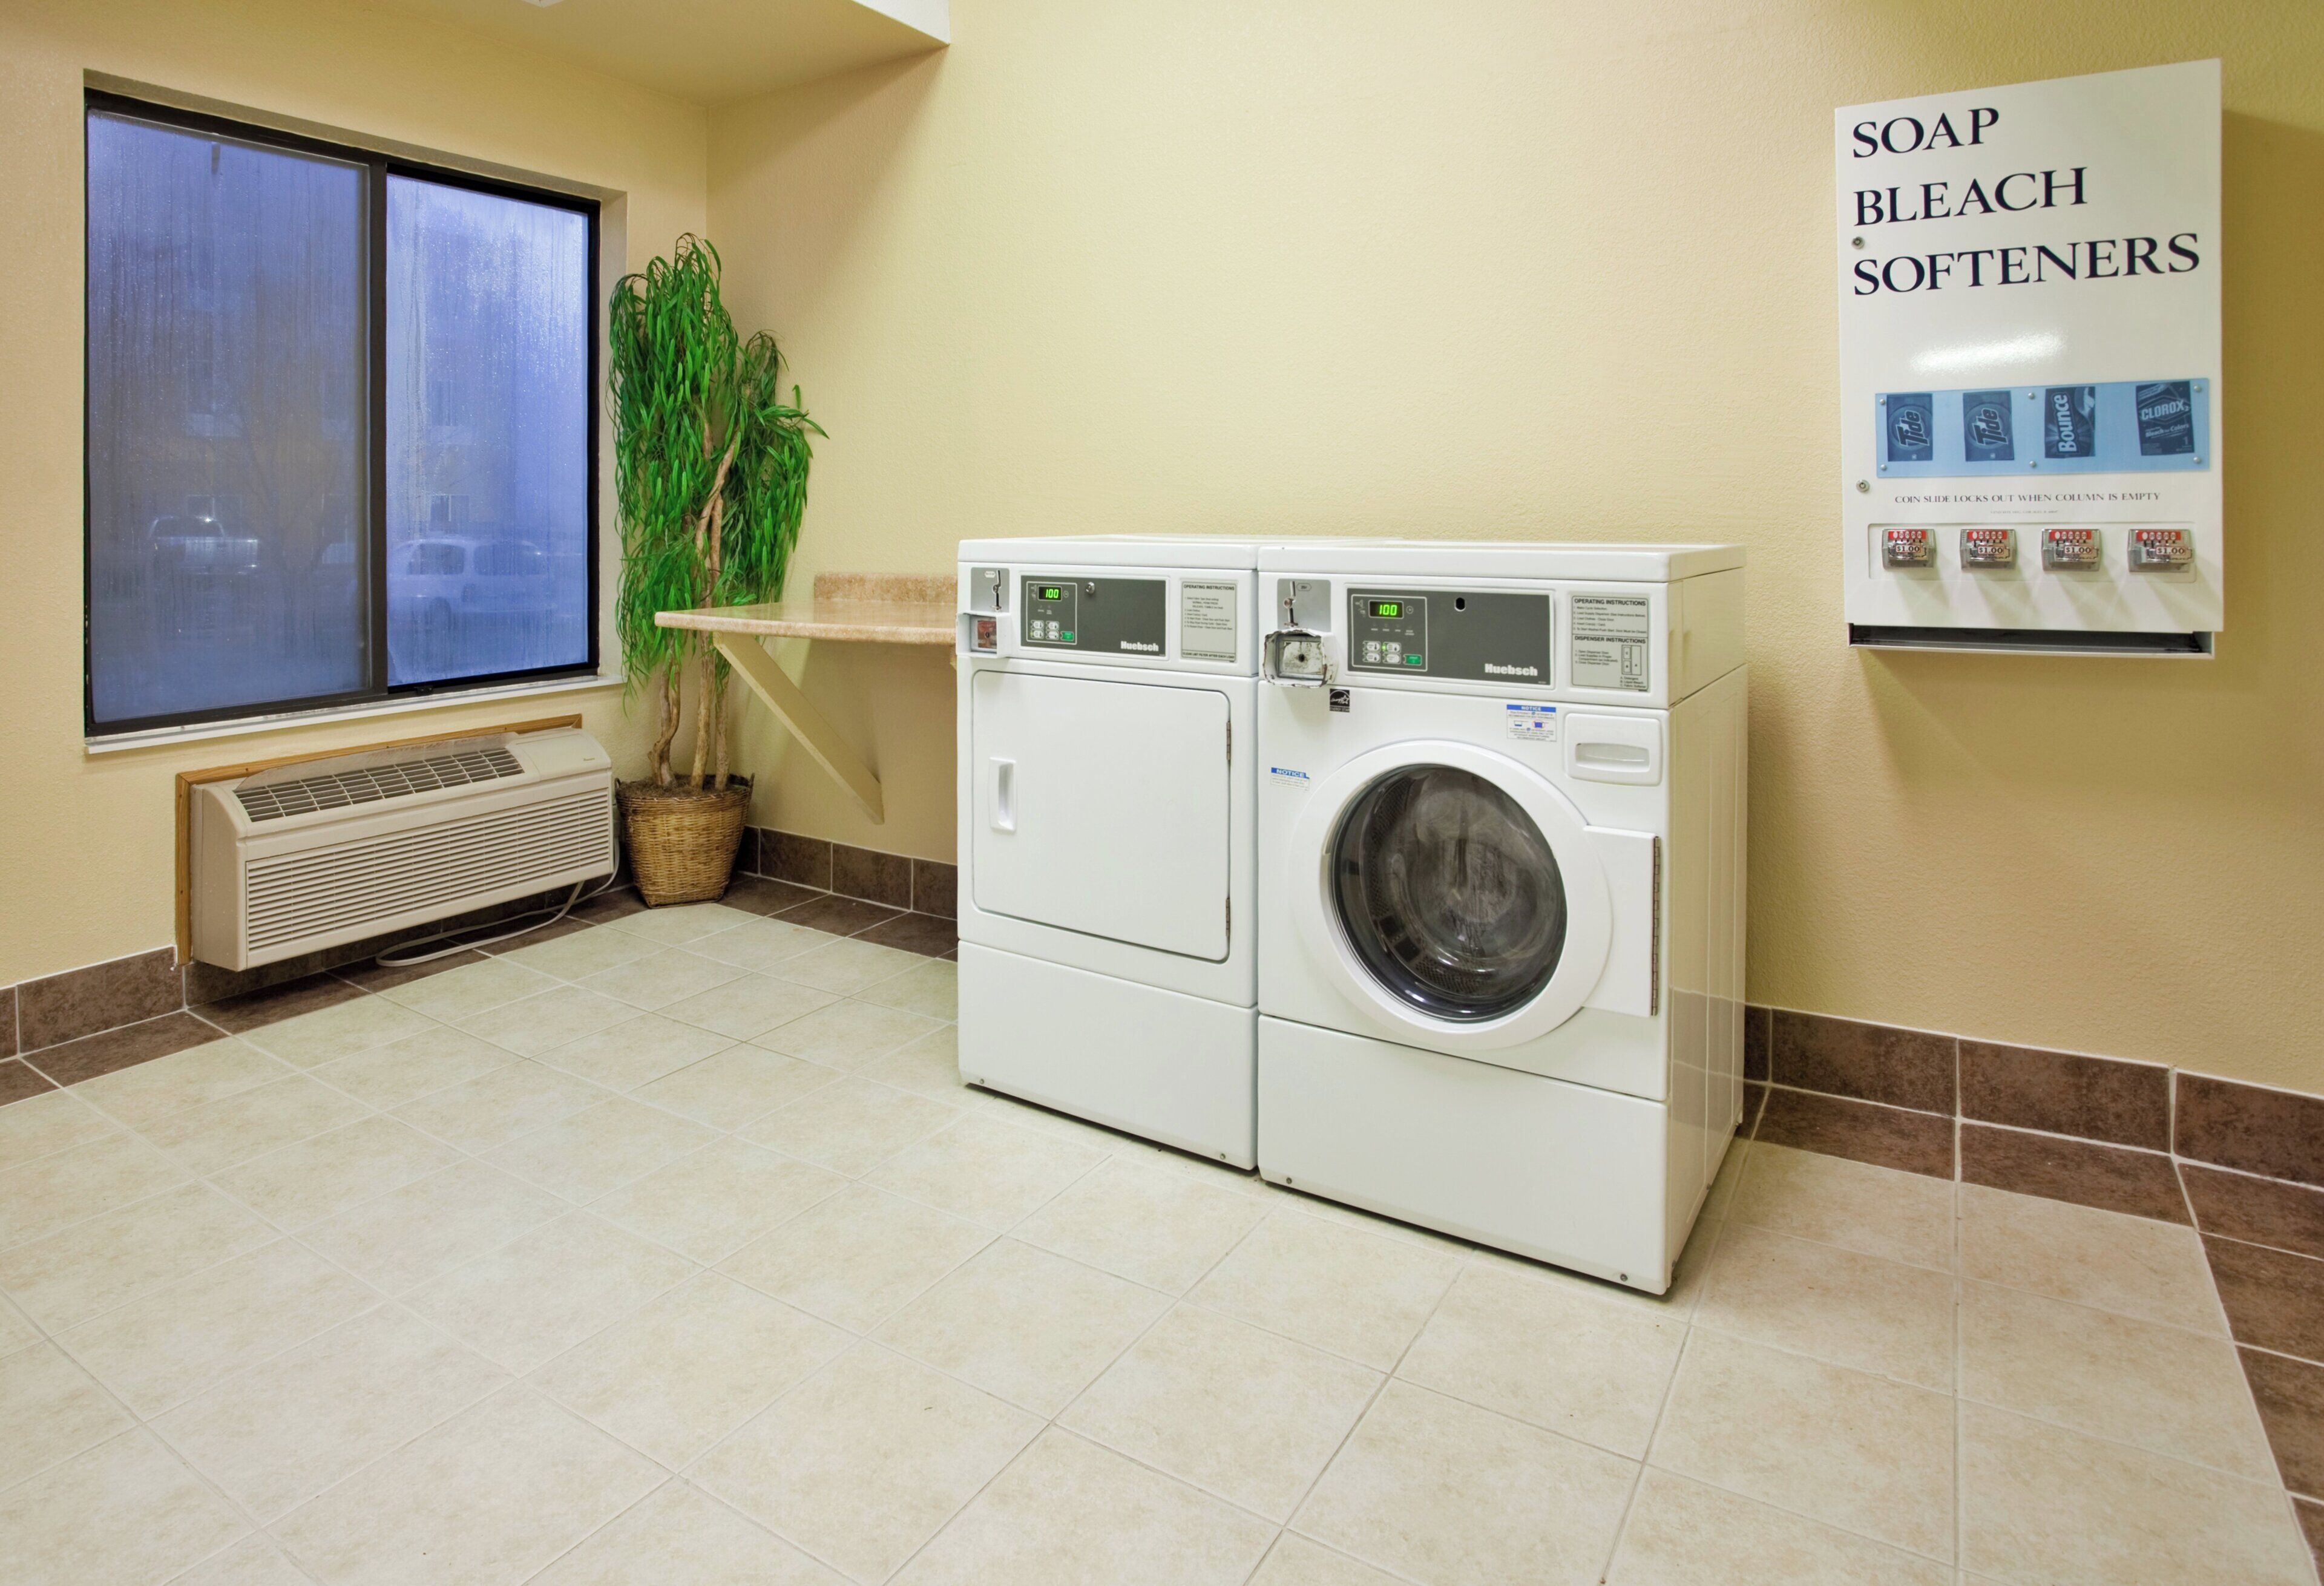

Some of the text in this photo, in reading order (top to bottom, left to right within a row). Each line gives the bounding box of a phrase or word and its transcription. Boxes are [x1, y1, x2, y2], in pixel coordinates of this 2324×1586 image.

[1853, 107, 2000, 159] SOAP
[1853, 166, 2088, 226] BLEACH
[1853, 232, 2200, 295] SOFTENERS
[1896, 410, 1929, 447] Tide
[1972, 408, 2008, 445] Tide
[2053, 394, 2077, 451] Bounce
[2055, 493, 2104, 502] COLUMN
[1046, 589, 1059, 598] 100
[1379, 604, 1397, 615] 100
[1121, 641, 1159, 652] Huebsch
[1485, 663, 1538, 677] Huebsch
[1276, 769, 1304, 778] NOTICE
